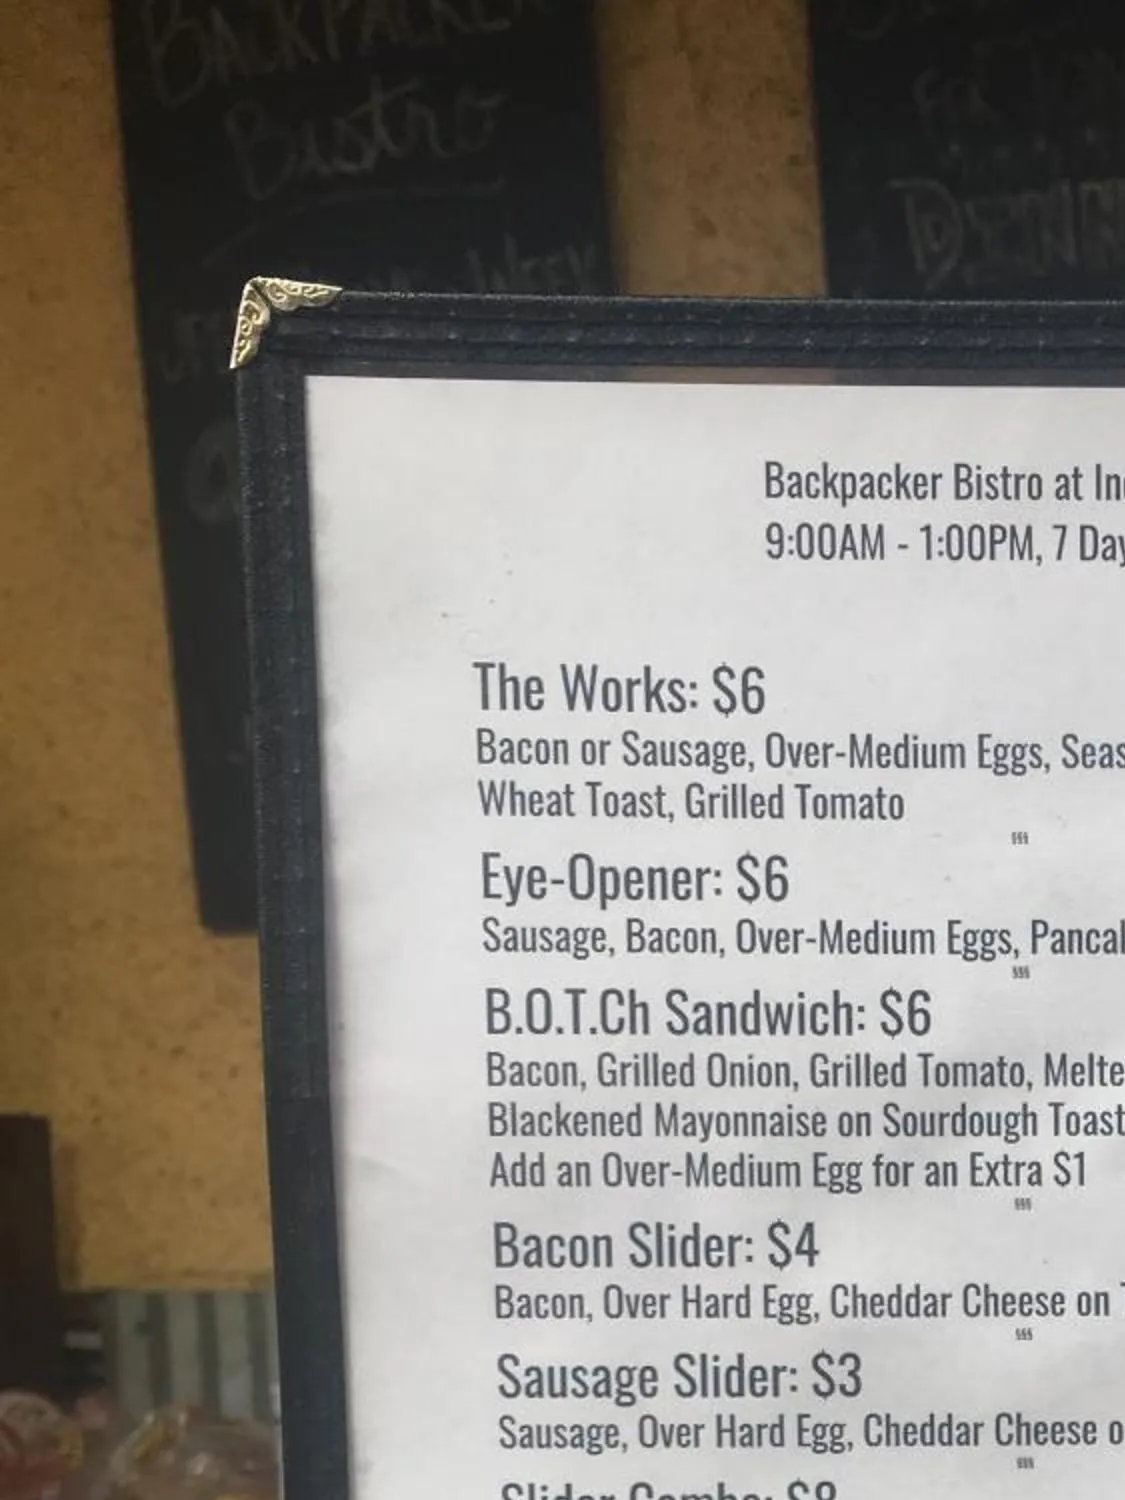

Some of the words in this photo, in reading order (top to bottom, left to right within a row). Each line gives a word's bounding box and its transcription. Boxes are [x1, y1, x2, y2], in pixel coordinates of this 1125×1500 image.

[764, 460, 944, 509] Backpacker
[953, 462, 1044, 502] Bistro
[1054, 465, 1085, 502] at
[765, 521, 886, 561] 9:00AM
[919, 522, 1043, 567] 1:00PM,
[1051, 523, 1069, 562] 7
[471, 661, 545, 712] The
[559, 663, 699, 714] Works:
[711, 661, 766, 719] $6
[475, 727, 570, 766] Bacon
[580, 738, 612, 767] or
[621, 729, 756, 776] Sausage,
[764, 731, 967, 770] Over-Medium
[977, 732, 1051, 777] Eggs,
[476, 778, 577, 818] Wheat
[584, 780, 675, 824] Toast,
[684, 781, 785, 820] Grilled
[793, 783, 905, 822] Tomato
[481, 851, 723, 912] Eye-Opener:
[735, 850, 790, 905] $6
[481, 915, 616, 961] Sausage,
[625, 917, 726, 959] Bacon,
[735, 917, 936, 956] Over-Medium
[946, 919, 1021, 963] Eggs,
[485, 986, 651, 1037] B.O.T.Ch
[664, 988, 866, 1037] Sandwich:
[879, 985, 932, 1041] $6
[485, 1050, 587, 1093] Bacon,
[596, 1051, 696, 1088] Grilled
[706, 1051, 800, 1093] Onion,
[809, 1051, 908, 1089] Grilled
[916, 1051, 1034, 1093] Tomato,
[487, 1100, 643, 1138] Blackened
[654, 1101, 828, 1144] Mayonnaise
[837, 1111, 872, 1138] on
[882, 1101, 1039, 1145] Sourdough
[489, 1151, 546, 1188] Add
[556, 1160, 592, 1188] an
[601, 1151, 802, 1189] Over-Medium
[811, 1151, 864, 1195] Egg
[871, 1152, 916, 1188] for
[923, 1160, 959, 1188] an
[969, 1151, 1044, 1188] Extra
[1052, 1149, 1086, 1189] $1
[492, 1221, 614, 1269] Bacon
[627, 1220, 754, 1269] Slider:
[767, 1217, 821, 1272] $4
[494, 1283, 593, 1324] Bacon,
[602, 1283, 672, 1320] Over
[681, 1283, 752, 1320] Hard
[762, 1283, 821, 1327] Egg,
[829, 1282, 954, 1320] Cheddar
[962, 1282, 1067, 1319] Cheese
[1076, 1290, 1111, 1317] on
[496, 1352, 660, 1409] Sausage
[672, 1351, 799, 1399] Slider:
[810, 1348, 863, 1401] $3
[498, 1414, 629, 1457] Sausage,
[637, 1413, 706, 1449] Over
[715, 1412, 786, 1449] Hard
[796, 1412, 854, 1455] Egg,
[863, 1411, 986, 1448] Cheddar
[994, 1411, 1098, 1447] Cheese
